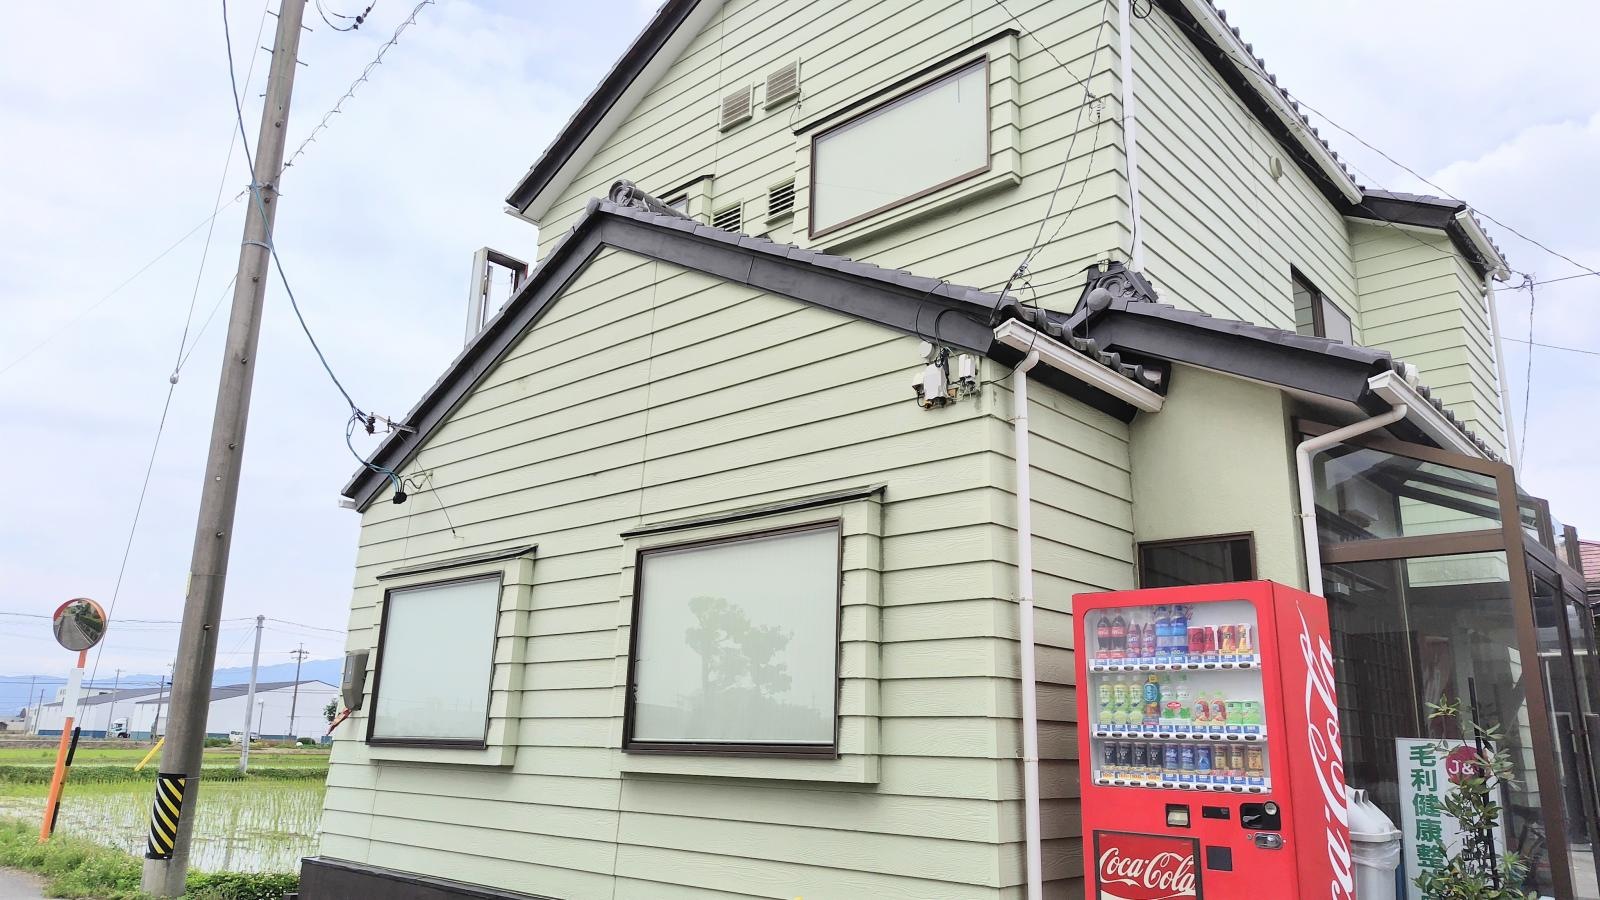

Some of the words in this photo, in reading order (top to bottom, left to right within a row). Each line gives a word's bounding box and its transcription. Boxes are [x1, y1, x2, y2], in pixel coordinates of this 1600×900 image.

[1100, 847, 1196, 893] Coca-Cola
[1409, 743, 1444, 900] 毛利健康整
